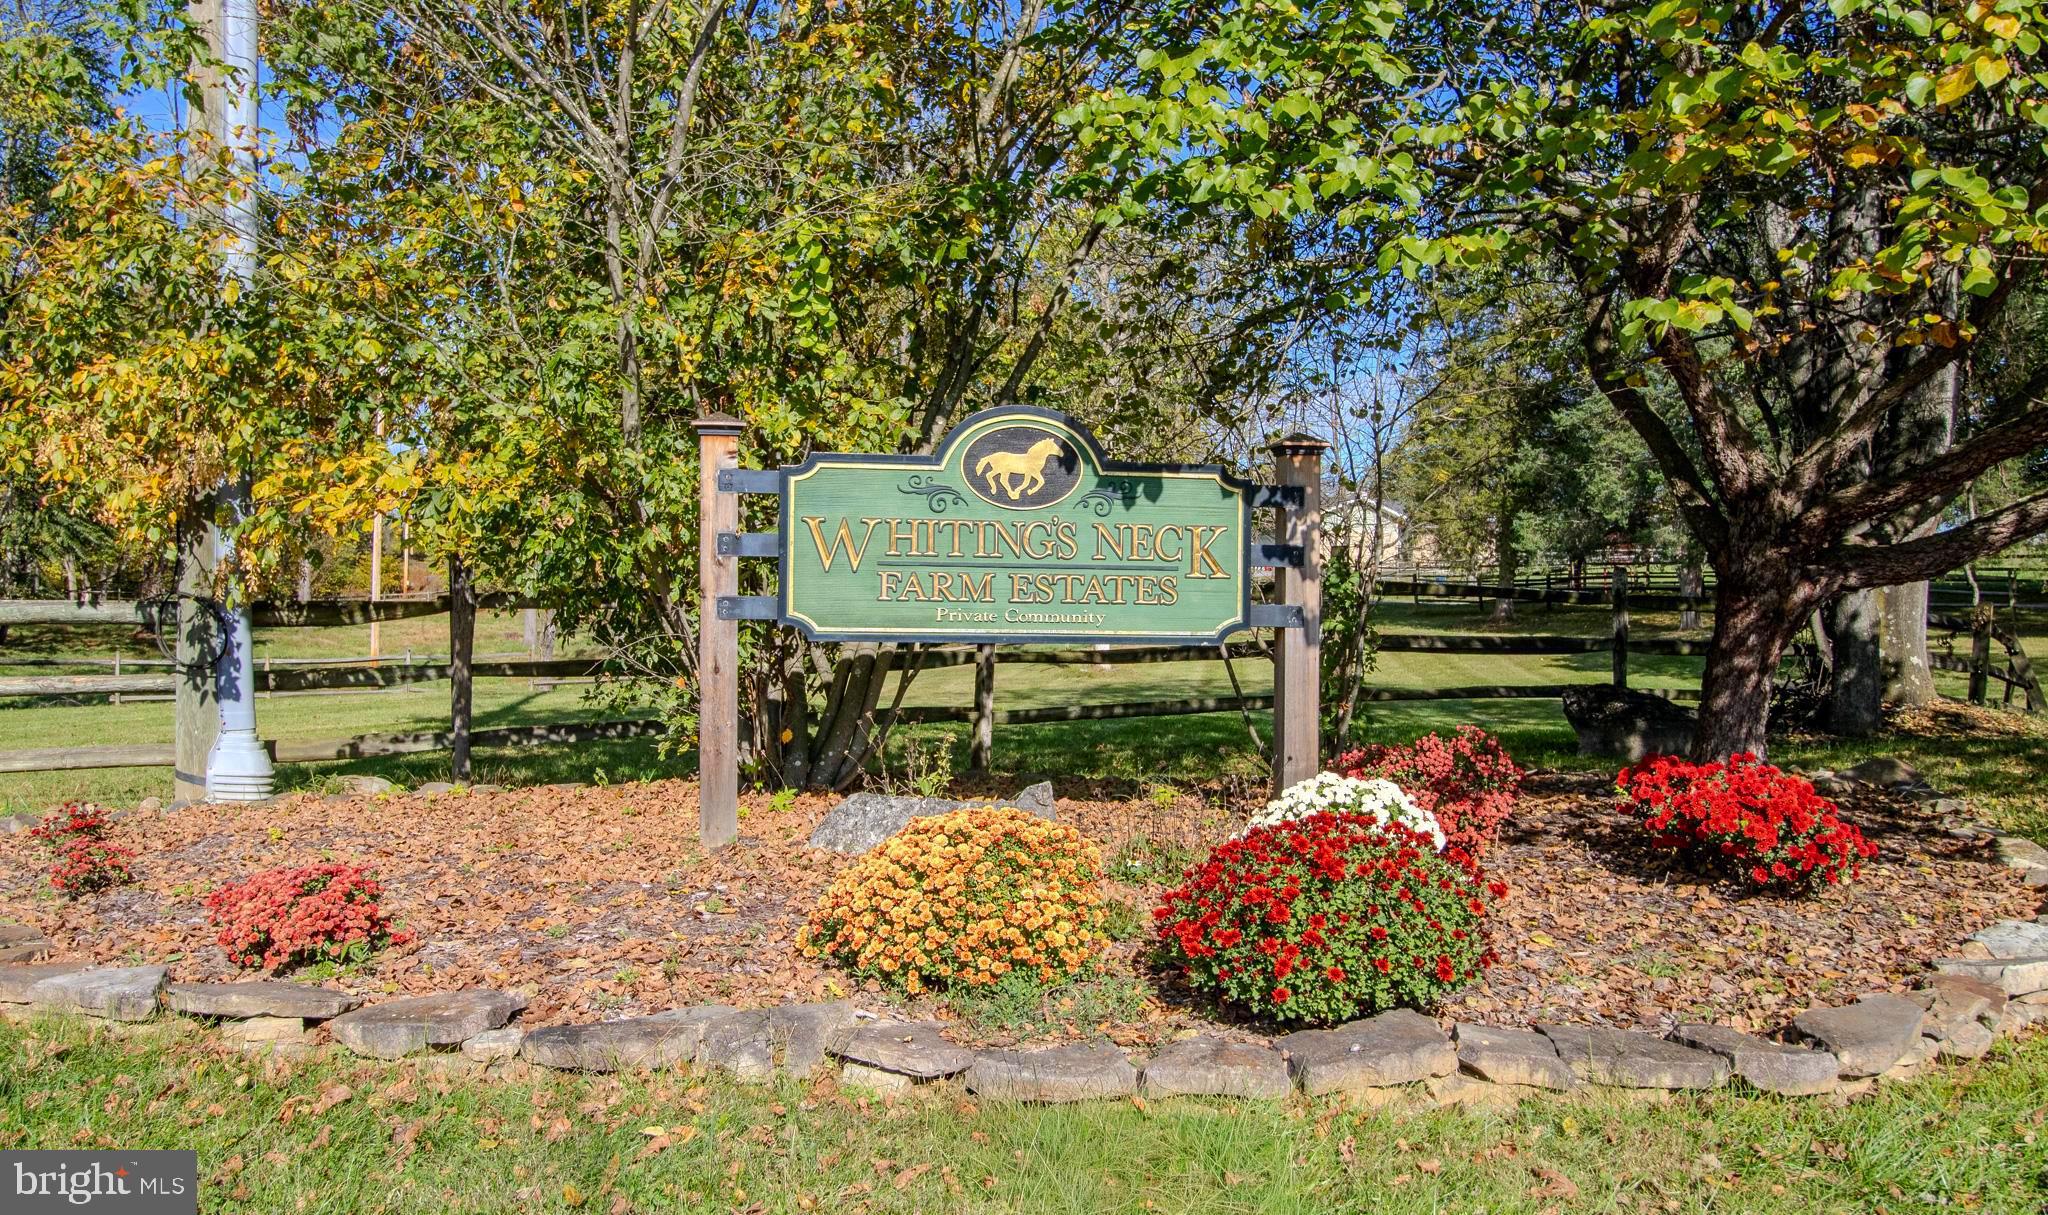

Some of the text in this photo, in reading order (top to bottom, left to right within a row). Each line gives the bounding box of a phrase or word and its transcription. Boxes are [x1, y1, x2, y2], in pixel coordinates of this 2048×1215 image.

[801, 515, 1231, 579] WHITING'S NECK
[877, 571, 1178, 606] FARM ESTATES
[936, 607, 1106, 628] Private Community
